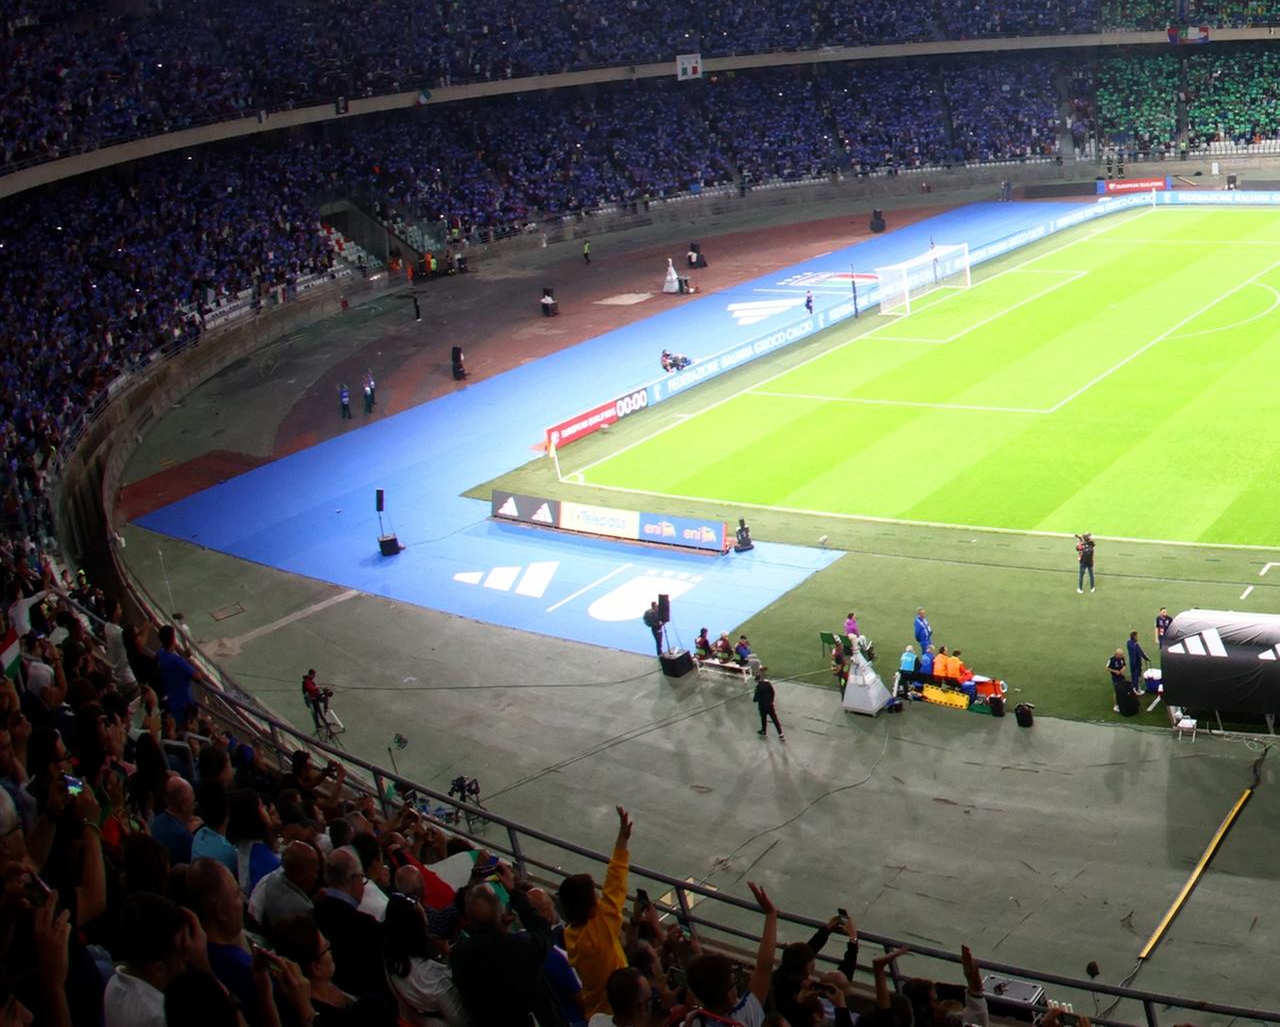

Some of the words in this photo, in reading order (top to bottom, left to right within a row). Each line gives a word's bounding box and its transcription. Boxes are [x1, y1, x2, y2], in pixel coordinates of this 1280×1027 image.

[617, 390, 648, 417] 00:00
[643, 523, 662, 536] eni
[683, 529, 701, 541] eni
